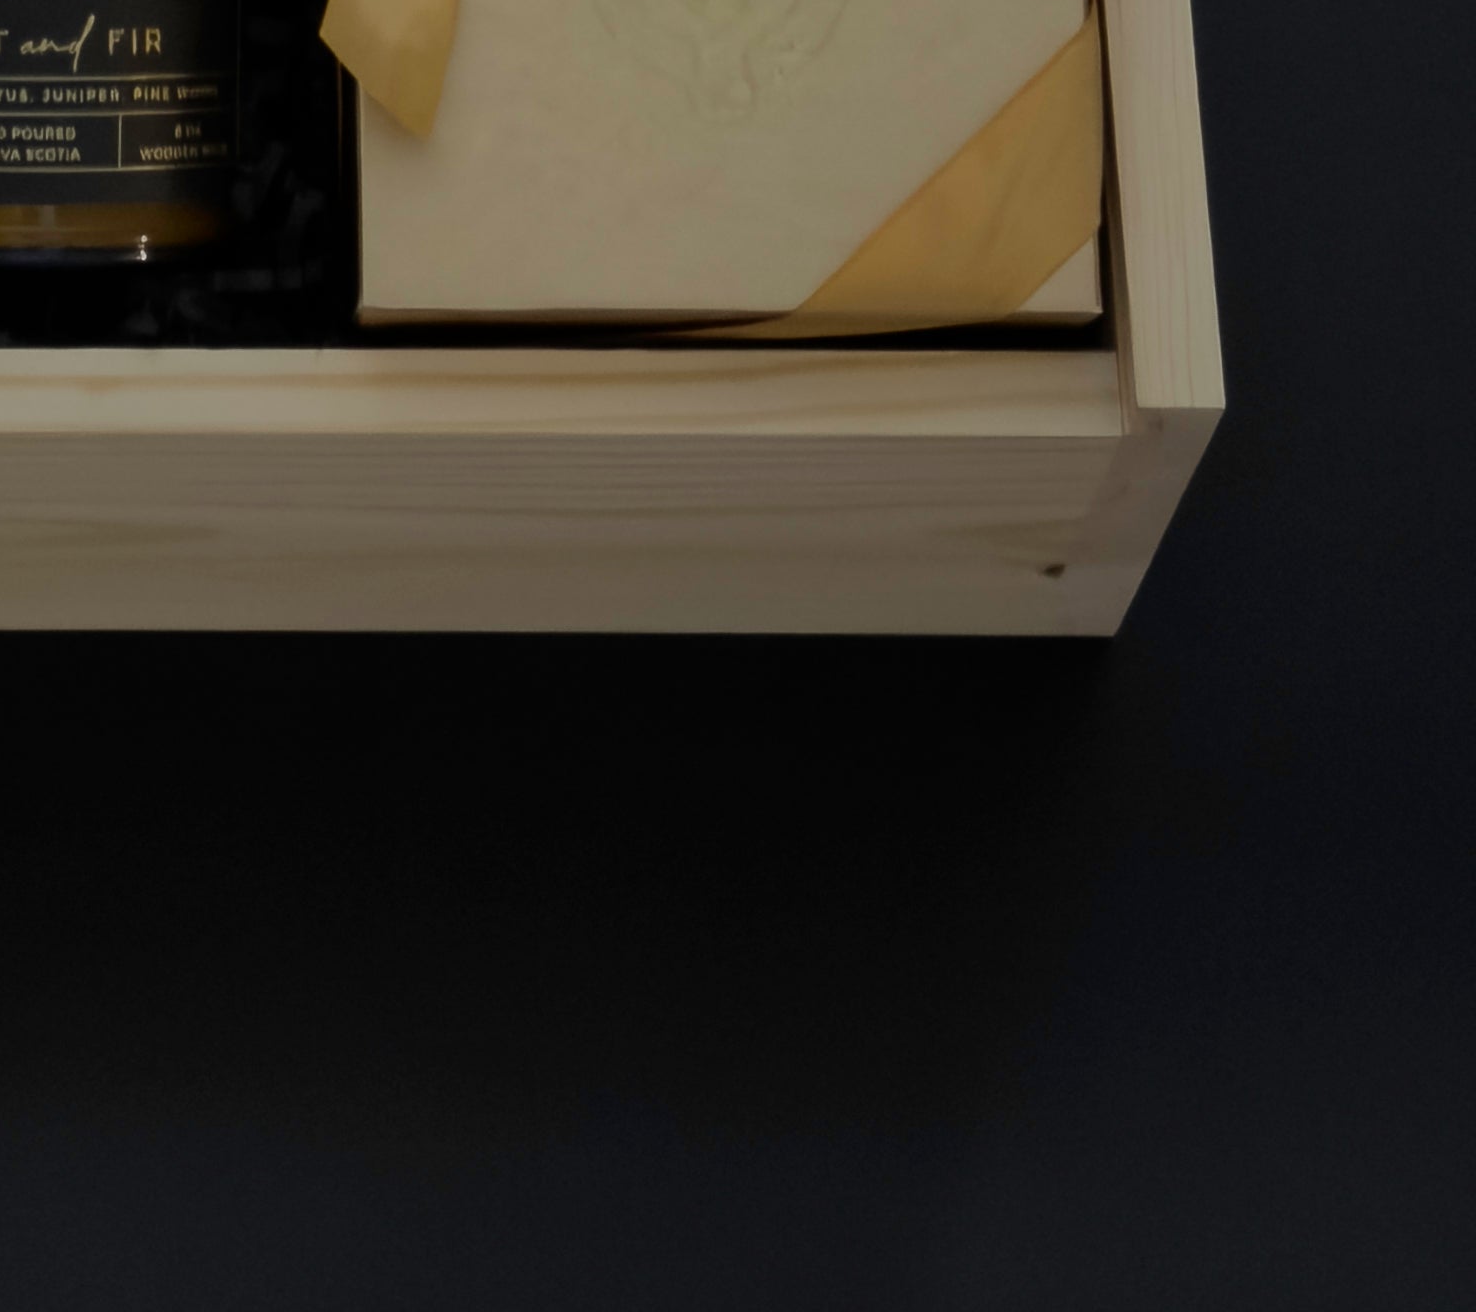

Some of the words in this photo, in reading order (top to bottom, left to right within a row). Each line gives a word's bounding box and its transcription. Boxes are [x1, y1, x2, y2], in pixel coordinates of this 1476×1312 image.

[20, 13, 95, 74] and
[108, 26, 163, 56] FIR
[12, 125, 76, 141] POURED
[26, 147, 81, 162] SCOTIA
